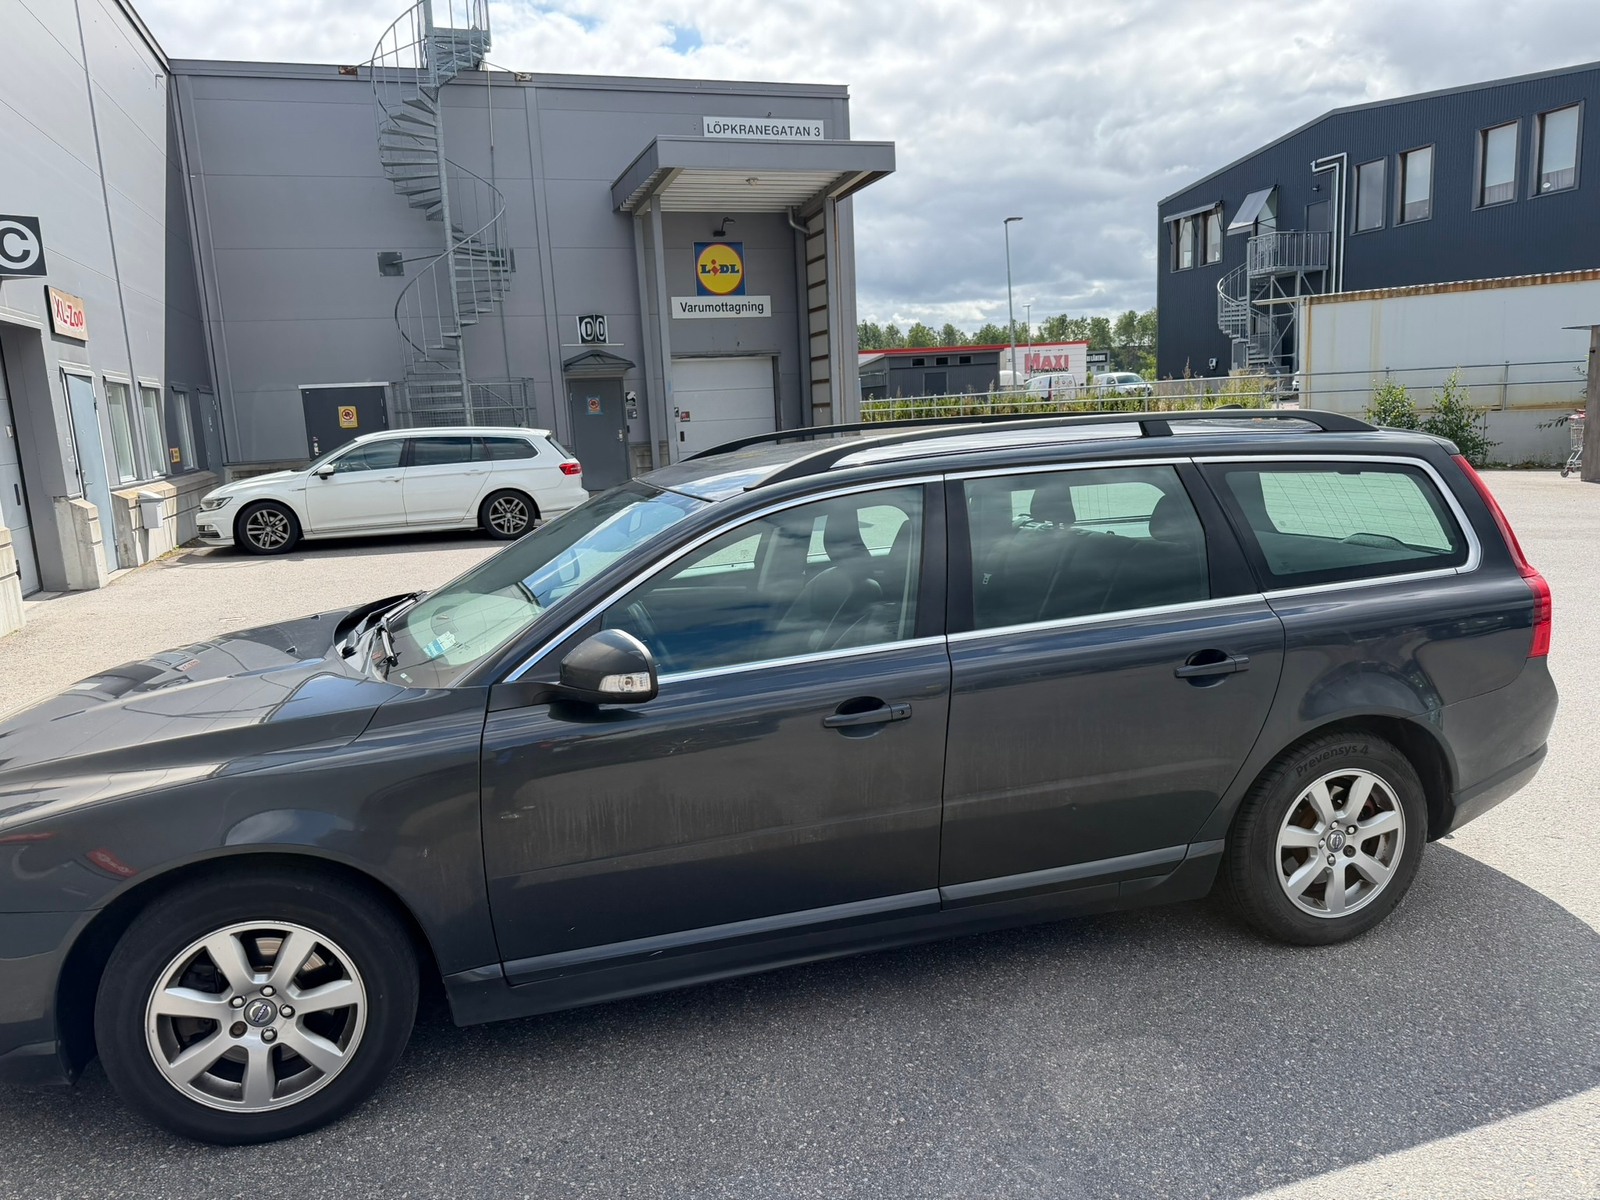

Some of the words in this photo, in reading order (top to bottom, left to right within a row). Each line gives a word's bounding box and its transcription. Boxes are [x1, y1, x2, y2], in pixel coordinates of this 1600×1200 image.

[707, 121, 811, 136] LÖPKRANEGATAN
[814, 126, 821, 137] 3
[0, 227, 30, 263] C
[680, 301, 764, 314] Varumottagning
[585, 320, 593, 338] D
[1296, 745, 1357, 777] Prevensys
[1360, 745, 1369, 756] 4
